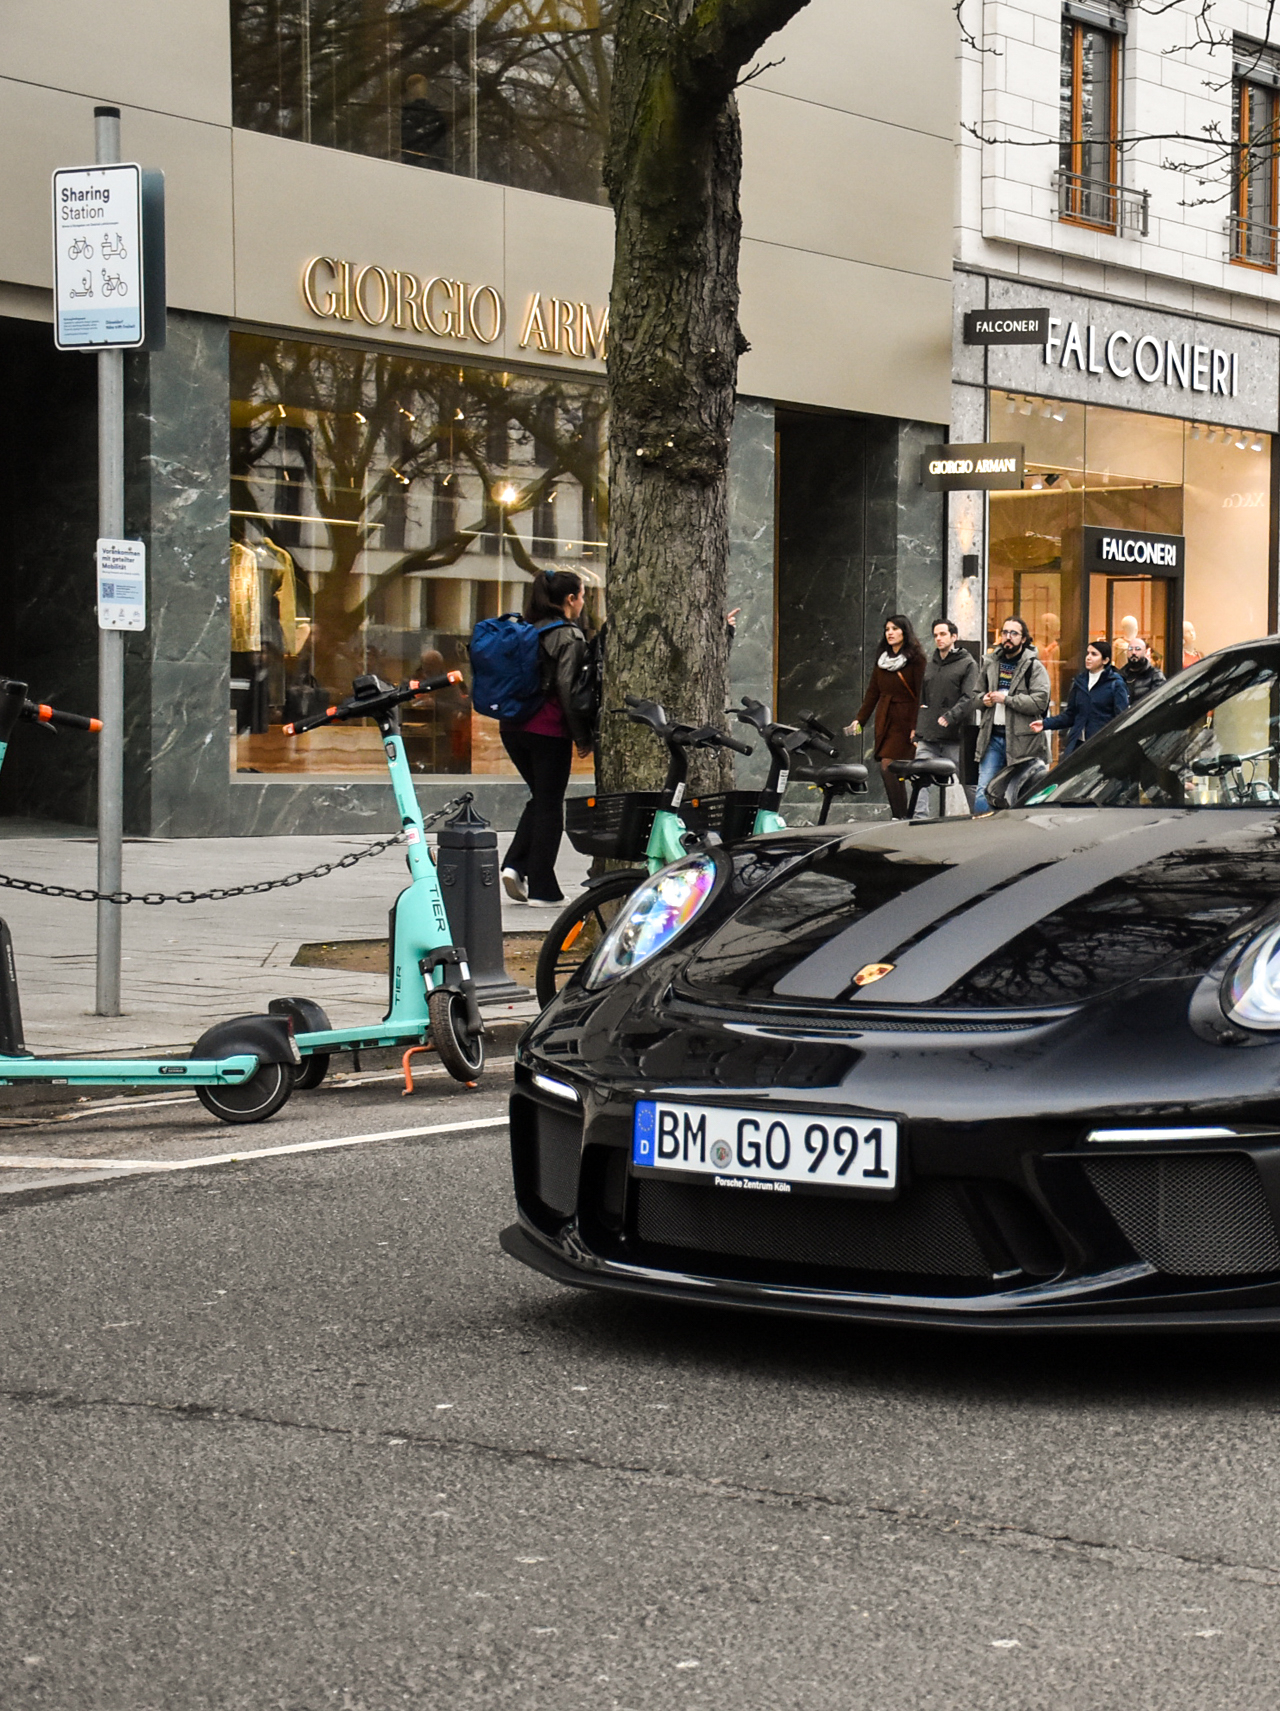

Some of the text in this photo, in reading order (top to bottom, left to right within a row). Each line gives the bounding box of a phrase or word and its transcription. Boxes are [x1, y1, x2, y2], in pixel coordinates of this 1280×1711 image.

[61, 186, 110, 203] Sharing
[61, 204, 104, 221] Station
[303, 255, 506, 345] GIORGIO
[975, 320, 1039, 333] FALCONERI
[1043, 317, 1239, 397] FALCONERI
[928, 458, 1017, 475] GIORGIO ARMANI
[101, 548, 141, 557] Vorankommen
[1102, 537, 1177, 566] FALCONERI
[429, 883, 447, 932] TIER
[640, 1110, 890, 1179] D BM GO 991
[714, 1176, 791, 1192] Porsche Zentrum Köln
